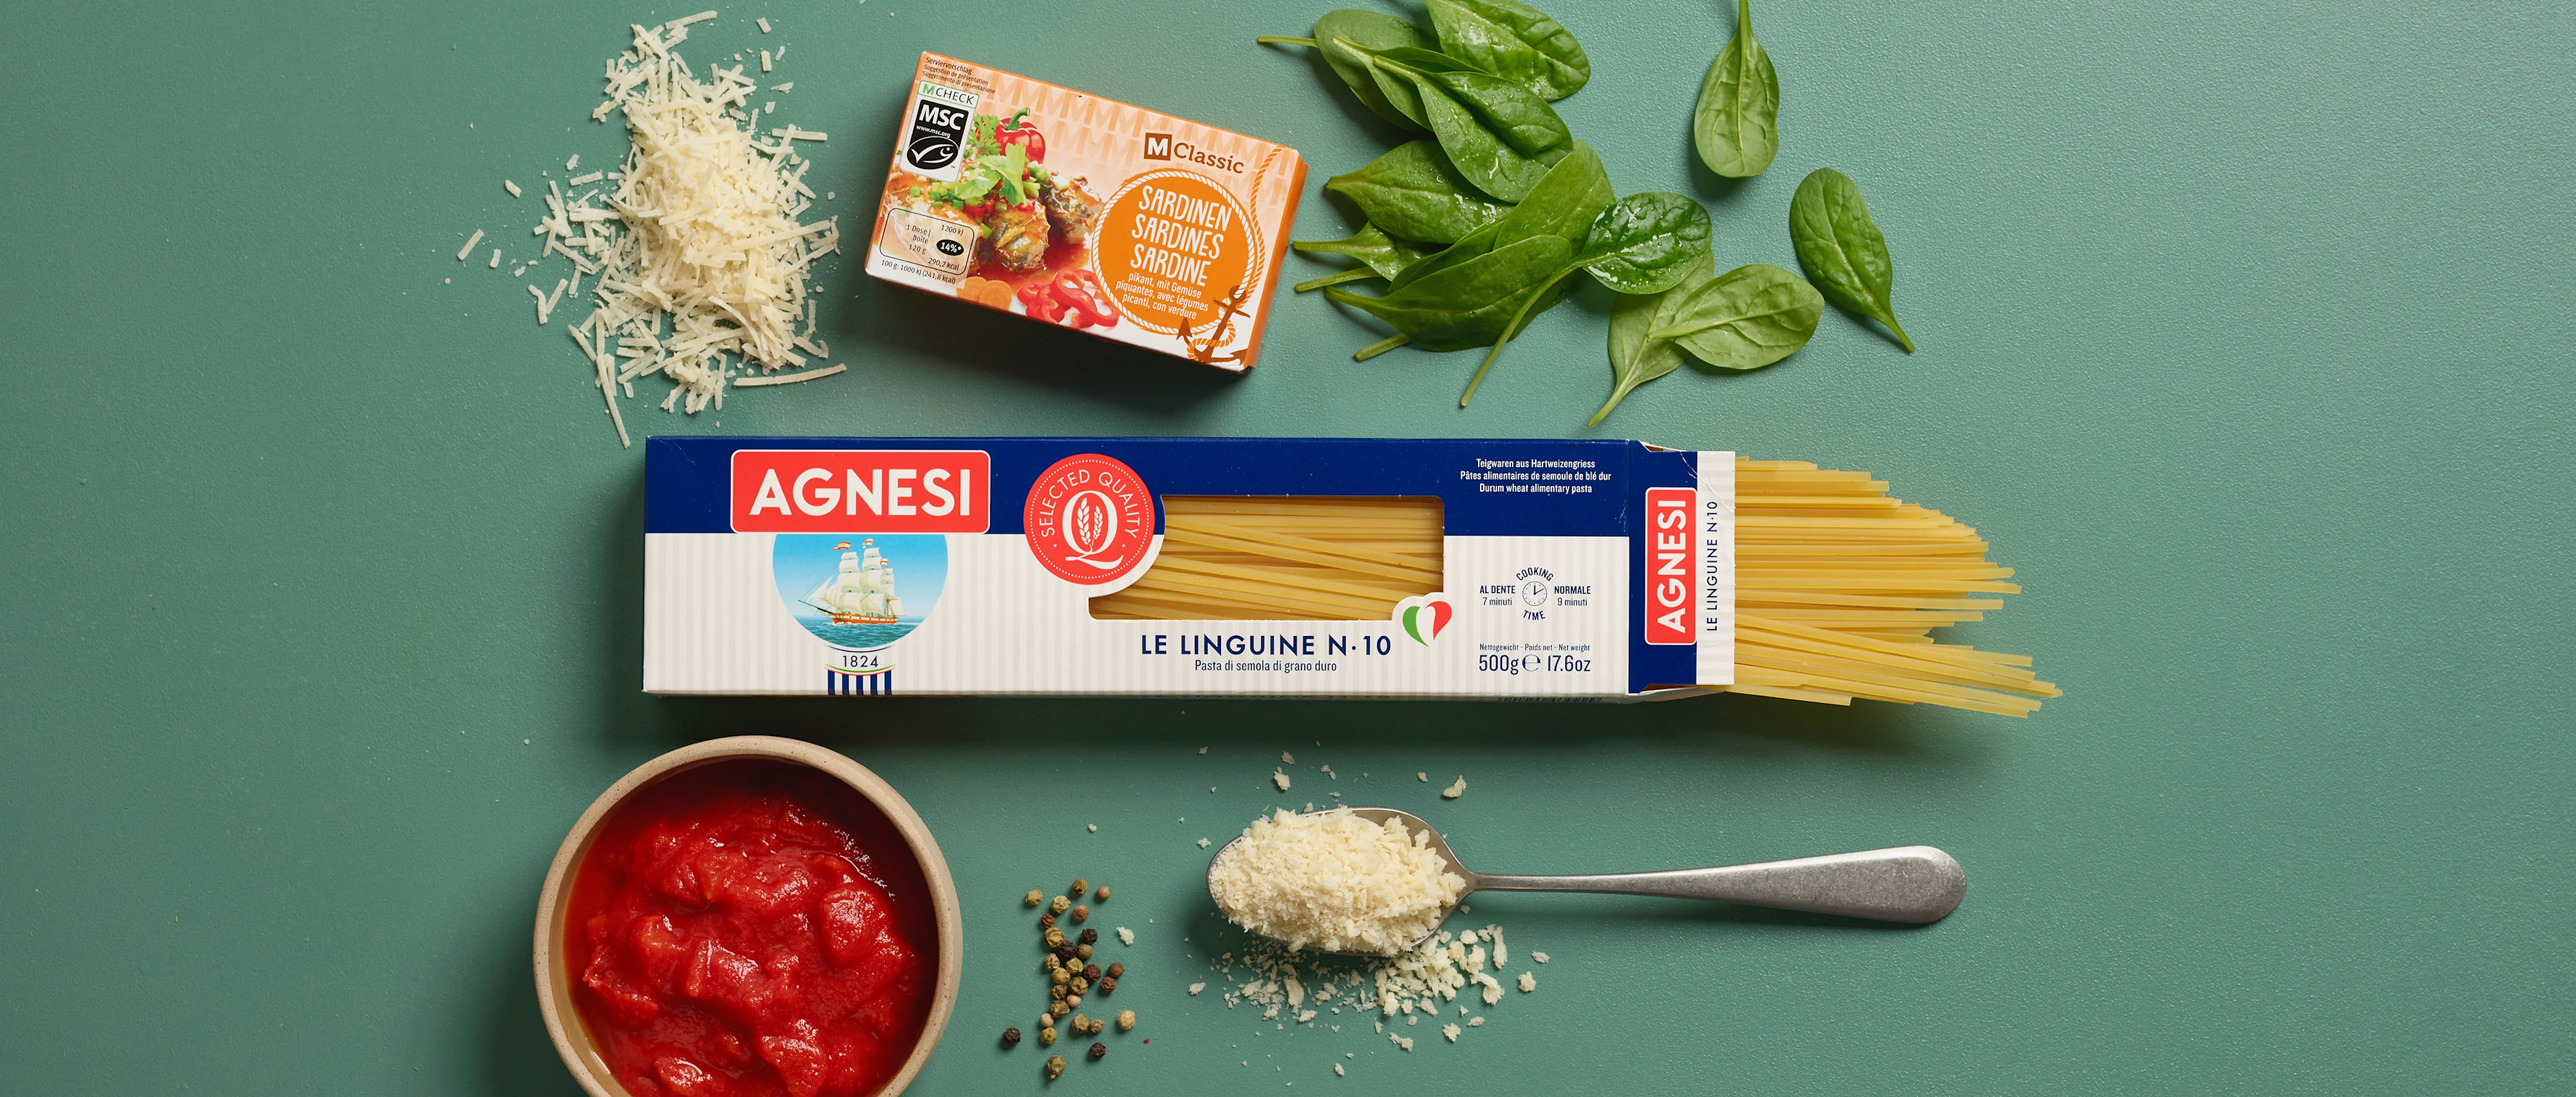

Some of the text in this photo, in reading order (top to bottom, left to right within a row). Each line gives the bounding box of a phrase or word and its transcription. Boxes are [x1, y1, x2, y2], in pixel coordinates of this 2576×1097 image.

[924, 64, 951, 76] Suggestion
[957, 74, 989, 85] présentation
[925, 57, 972, 75] Serviervorschlag
[922, 71, 955, 83] Suggerimento
[961, 83, 996, 95] presentazione
[922, 84, 975, 105] M CHECK
[918, 104, 965, 131] MSC
[916, 125, 951, 139] www.msc.org
[1147, 137, 1245, 174] M Classic
[1138, 185, 1232, 232] SARDINEN
[912, 225, 928, 235] Dose
[941, 224, 964, 237] 1200 kJ
[1131, 213, 1224, 260] SARDINES
[908, 244, 921, 252] 120
[912, 235, 929, 244] boîte
[881, 259, 893, 268] 100
[900, 264, 915, 274] 1000
[915, 268, 922, 276] kJ
[922, 270, 942, 280] (241,8
[942, 274, 956, 285] kcal)
[928, 257, 960, 272] 290,2 kcal
[1130, 243, 1212, 286] SARDINE
[1128, 272, 1202, 299] pikant, mit Gemüse
[1115, 280, 1209, 312] piquantes, avec légumes
[1122, 293, 1197, 320] picanti, con verdure
[1477, 458, 1514, 469] Teigwaren
[1531, 459, 1595, 470] Hartweizengriess
[1460, 471, 1611, 480] Pâtes alimentaires de semoule de blé dur
[749, 468, 970, 516] AGNESI
[1479, 483, 1593, 494] Durum wheat alimentary pasta
[1039, 469, 1140, 539] SELECTED QUALITY
[1062, 490, 1124, 570] Q
[1516, 567, 1554, 582] COOKING
[1657, 501, 1686, 633] AGNESI
[1707, 539, 1717, 610] LINGUINE
[1480, 586, 1516, 594] AL DENTE
[1554, 586, 1591, 594] NORMALE
[1483, 597, 1513, 605] 7 minuti
[1557, 597, 1588, 606] 9 minuti
[1523, 610, 1546, 621] TIME
[1707, 617, 1717, 631] LE
[1141, 635, 1167, 654] LE
[1181, 633, 1315, 656] LINGUINE
[1480, 643, 1519, 652] Nettogewicht
[1570, 644, 1590, 652] weight
[843, 655, 879, 668] 1824
[1195, 660, 1337, 674] Pasta di semola di grano duro
[1479, 654, 1519, 675] 500g
[1548, 655, 1591, 672] 17.6oz
